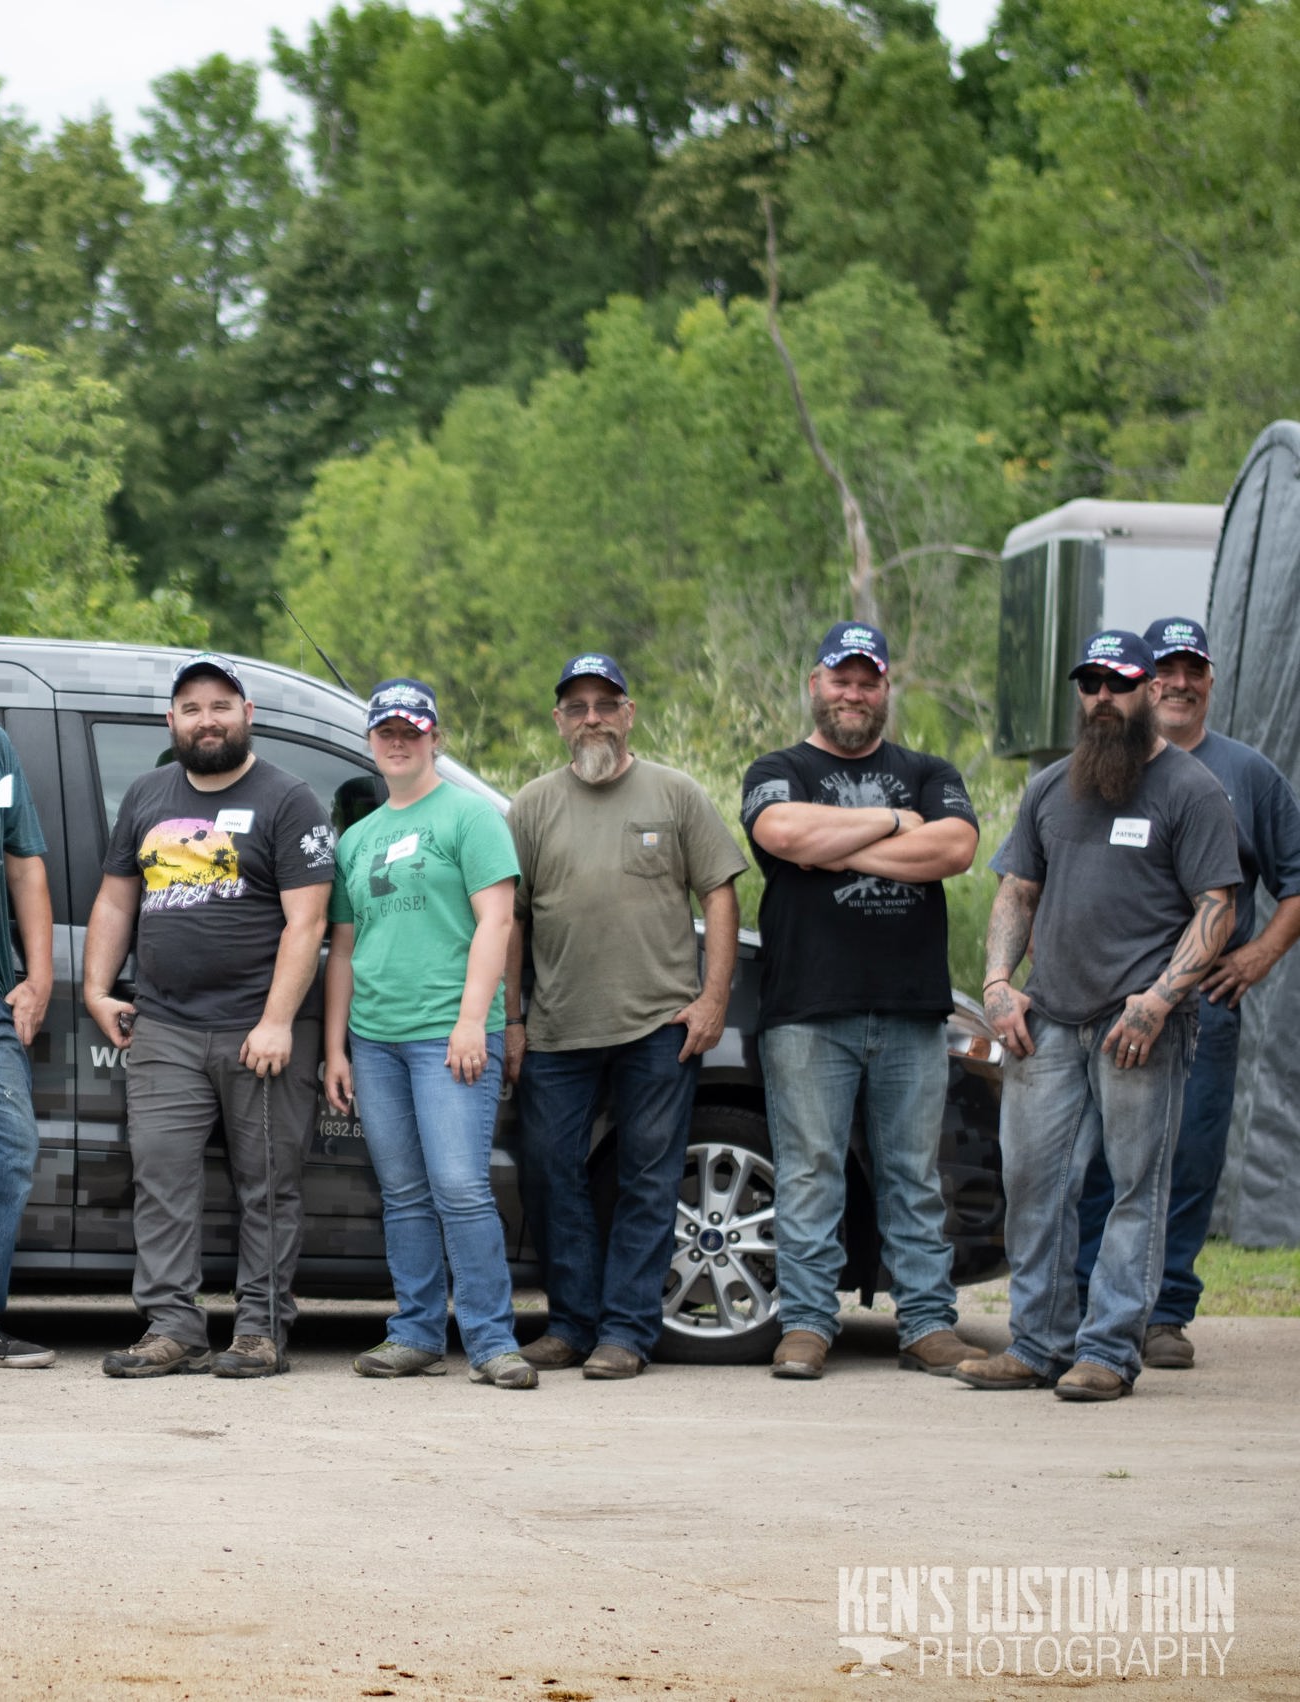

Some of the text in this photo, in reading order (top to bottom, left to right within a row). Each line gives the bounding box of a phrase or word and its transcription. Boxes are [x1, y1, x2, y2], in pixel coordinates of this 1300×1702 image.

[166, 883, 212, 909] BASH
[380, 895, 428, 918] GOOSE!
[319, 1120, 366, 1138] (832.6
